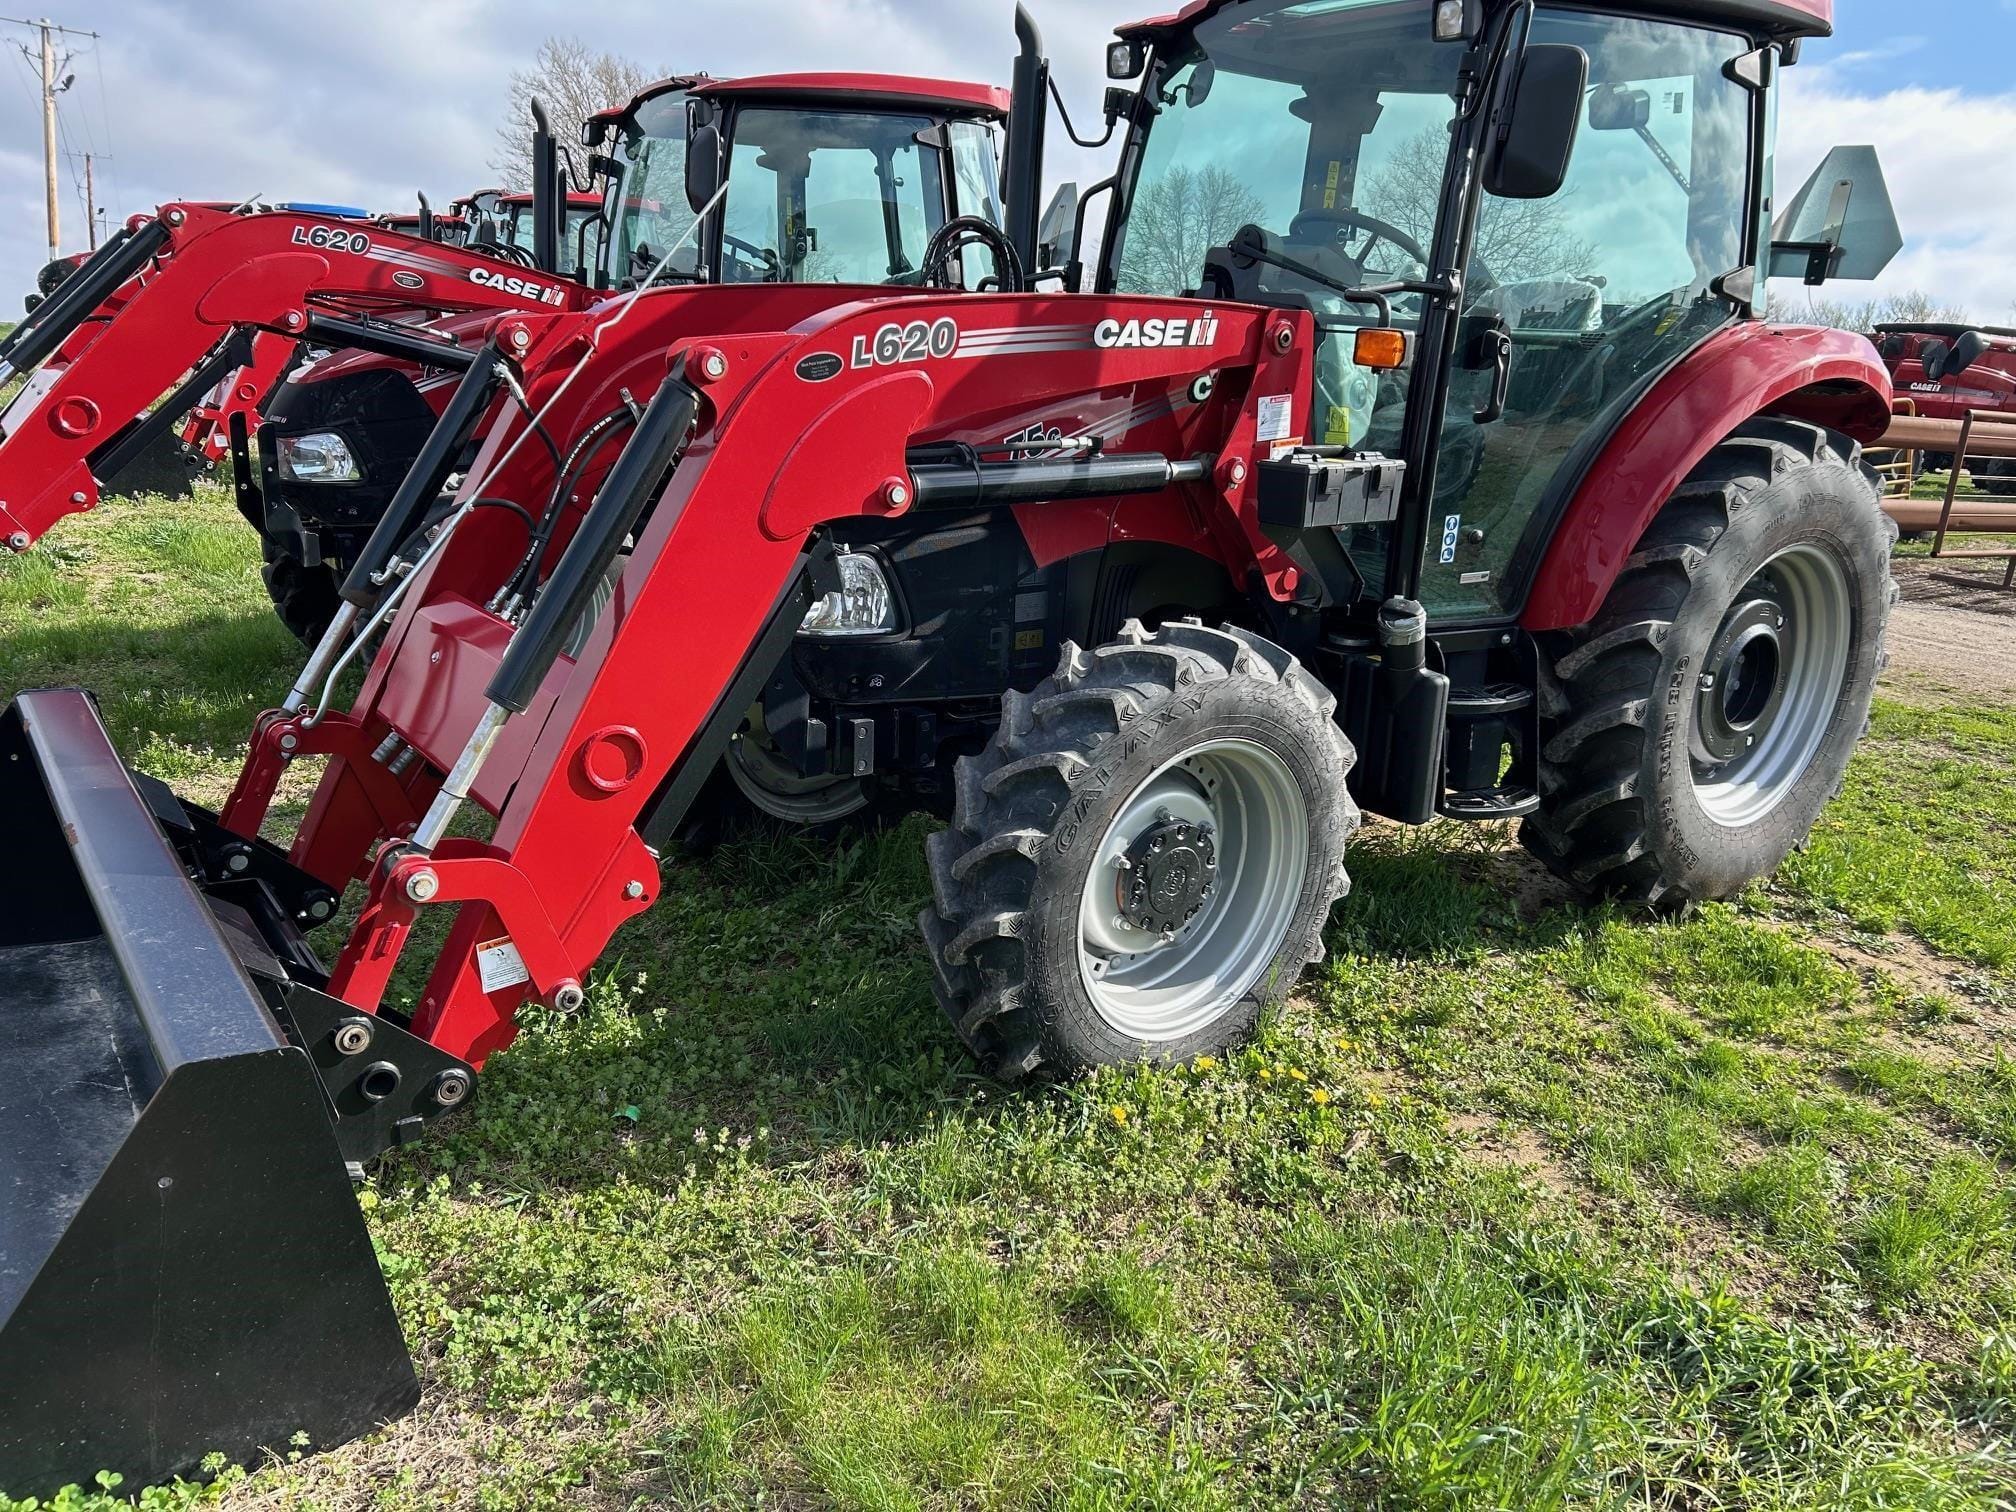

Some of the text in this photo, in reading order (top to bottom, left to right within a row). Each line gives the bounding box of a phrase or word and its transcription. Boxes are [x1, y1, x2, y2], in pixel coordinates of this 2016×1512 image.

[291, 225, 370, 255] L620
[469, 267, 541, 300] CASE
[851, 316, 958, 370] L620
[1093, 318, 1187, 348] CASE
[1910, 382, 1933, 392] CASE
[1055, 689, 1209, 855] GALAXY
